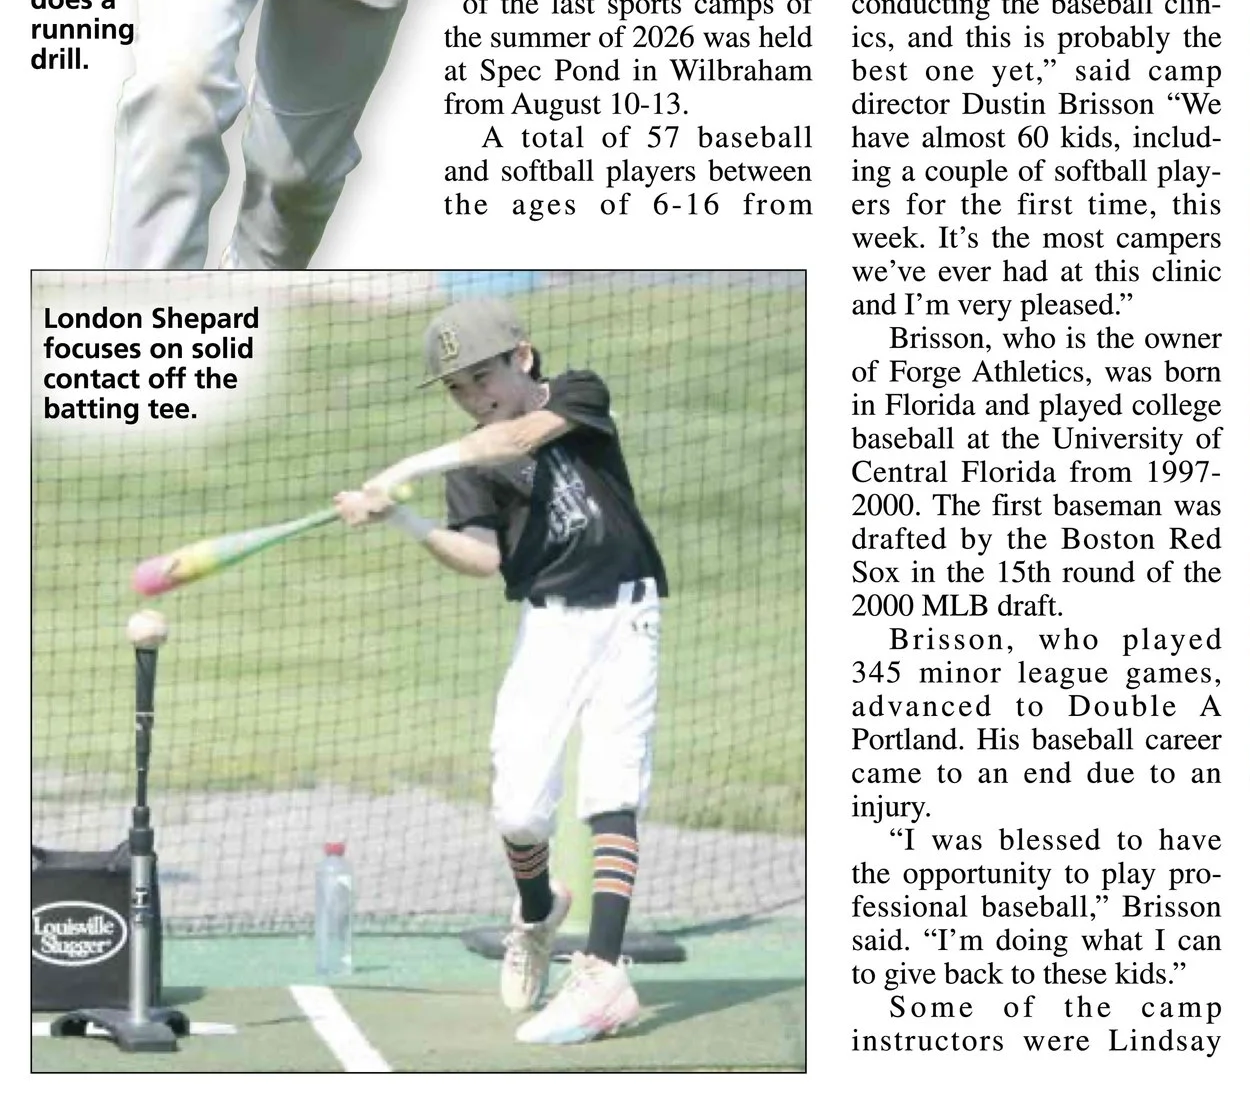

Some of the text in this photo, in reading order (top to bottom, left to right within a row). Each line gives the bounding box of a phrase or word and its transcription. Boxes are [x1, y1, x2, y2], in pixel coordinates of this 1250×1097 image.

[31, 17, 134, 46] running
[30, 47, 89, 70] drill.
[444, 58, 813, 88] at Spec Pond in Wilbraham
[443, 91, 689, 122] from August 10-13.
[851, 91, 1222, 115] director Dustin Brisson “We
[443, 192, 813, 222] the ages of 6-16 from
[44, 306, 259, 335] London Shepard
[43, 336, 253, 359] focuses on solid
[43, 366, 238, 389] contact off the
[44, 396, 197, 425] batting tee.
[851, 392, 1222, 423] in Florida and played college
[851, 459, 1221, 484] Central Florida from 1997-
[851, 593, 1063, 617] 2000 MLB draft.
[851, 794, 931, 824] injury.
[851, 894, 1222, 922] fessional baseball,” Brisson
[33, 914, 115, 936] Louisville
[40, 934, 107, 958] Slugger
[851, 1028, 1222, 1058] instructors were Lindsay
